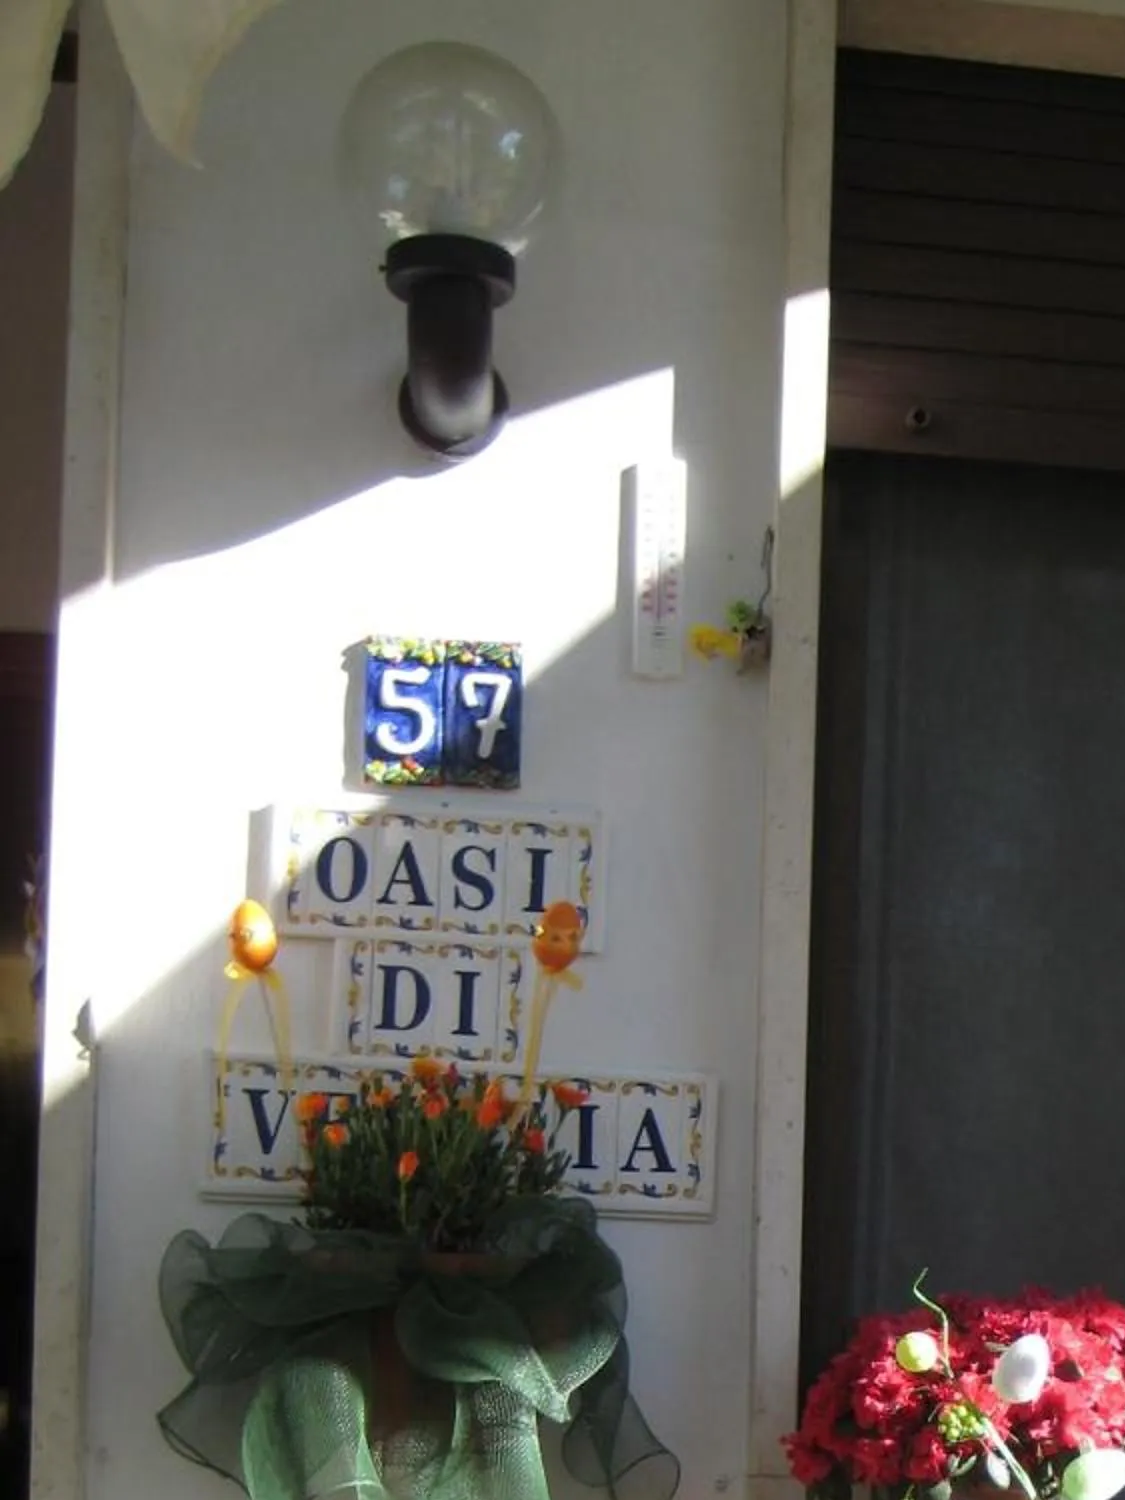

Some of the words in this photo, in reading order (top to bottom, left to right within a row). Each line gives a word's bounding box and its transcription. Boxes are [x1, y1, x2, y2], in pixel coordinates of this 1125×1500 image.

[375, 668, 513, 759] 57
[315, 836, 553, 913] OASI
[374, 964, 480, 1037] DI
